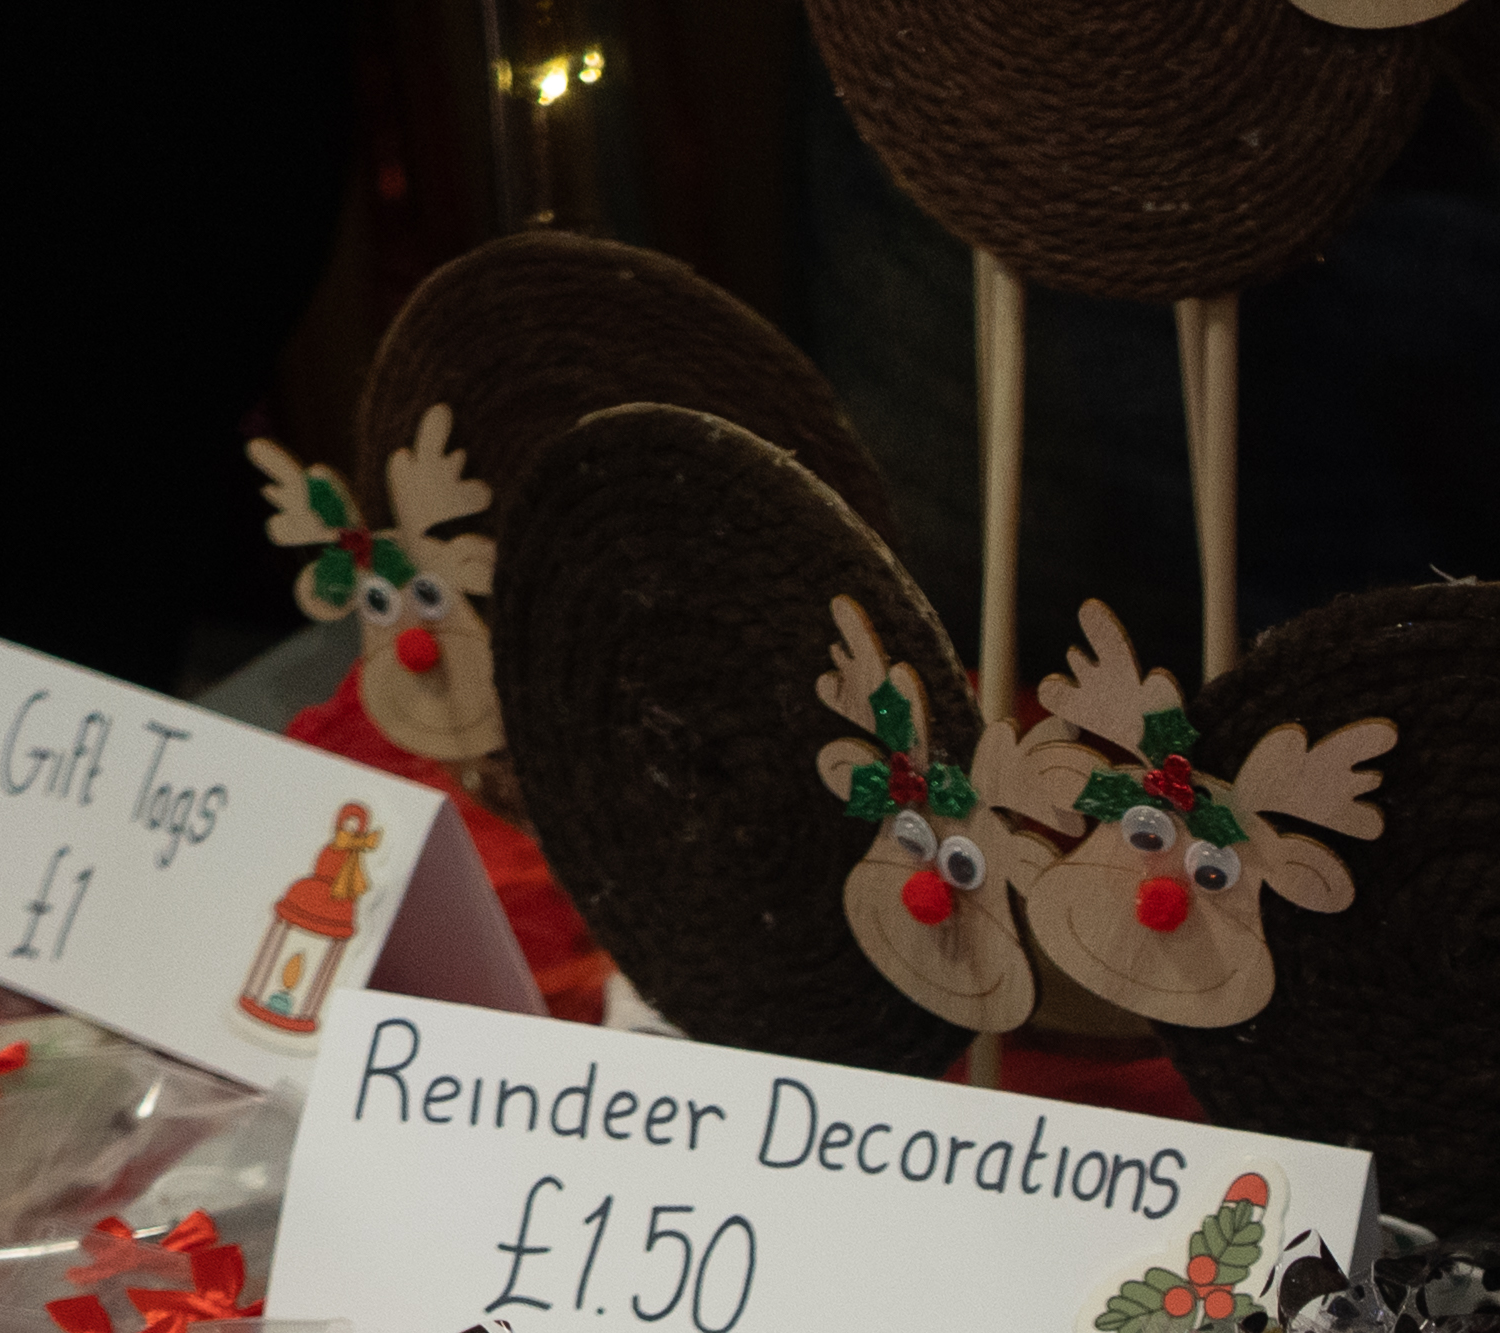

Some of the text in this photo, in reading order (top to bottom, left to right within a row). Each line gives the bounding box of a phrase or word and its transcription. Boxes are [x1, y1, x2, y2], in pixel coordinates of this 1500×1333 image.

[129, 718, 231, 871] Tags
[6, 843, 97, 962] £1
[354, 1017, 1189, 1222] Reindeer Decorations
